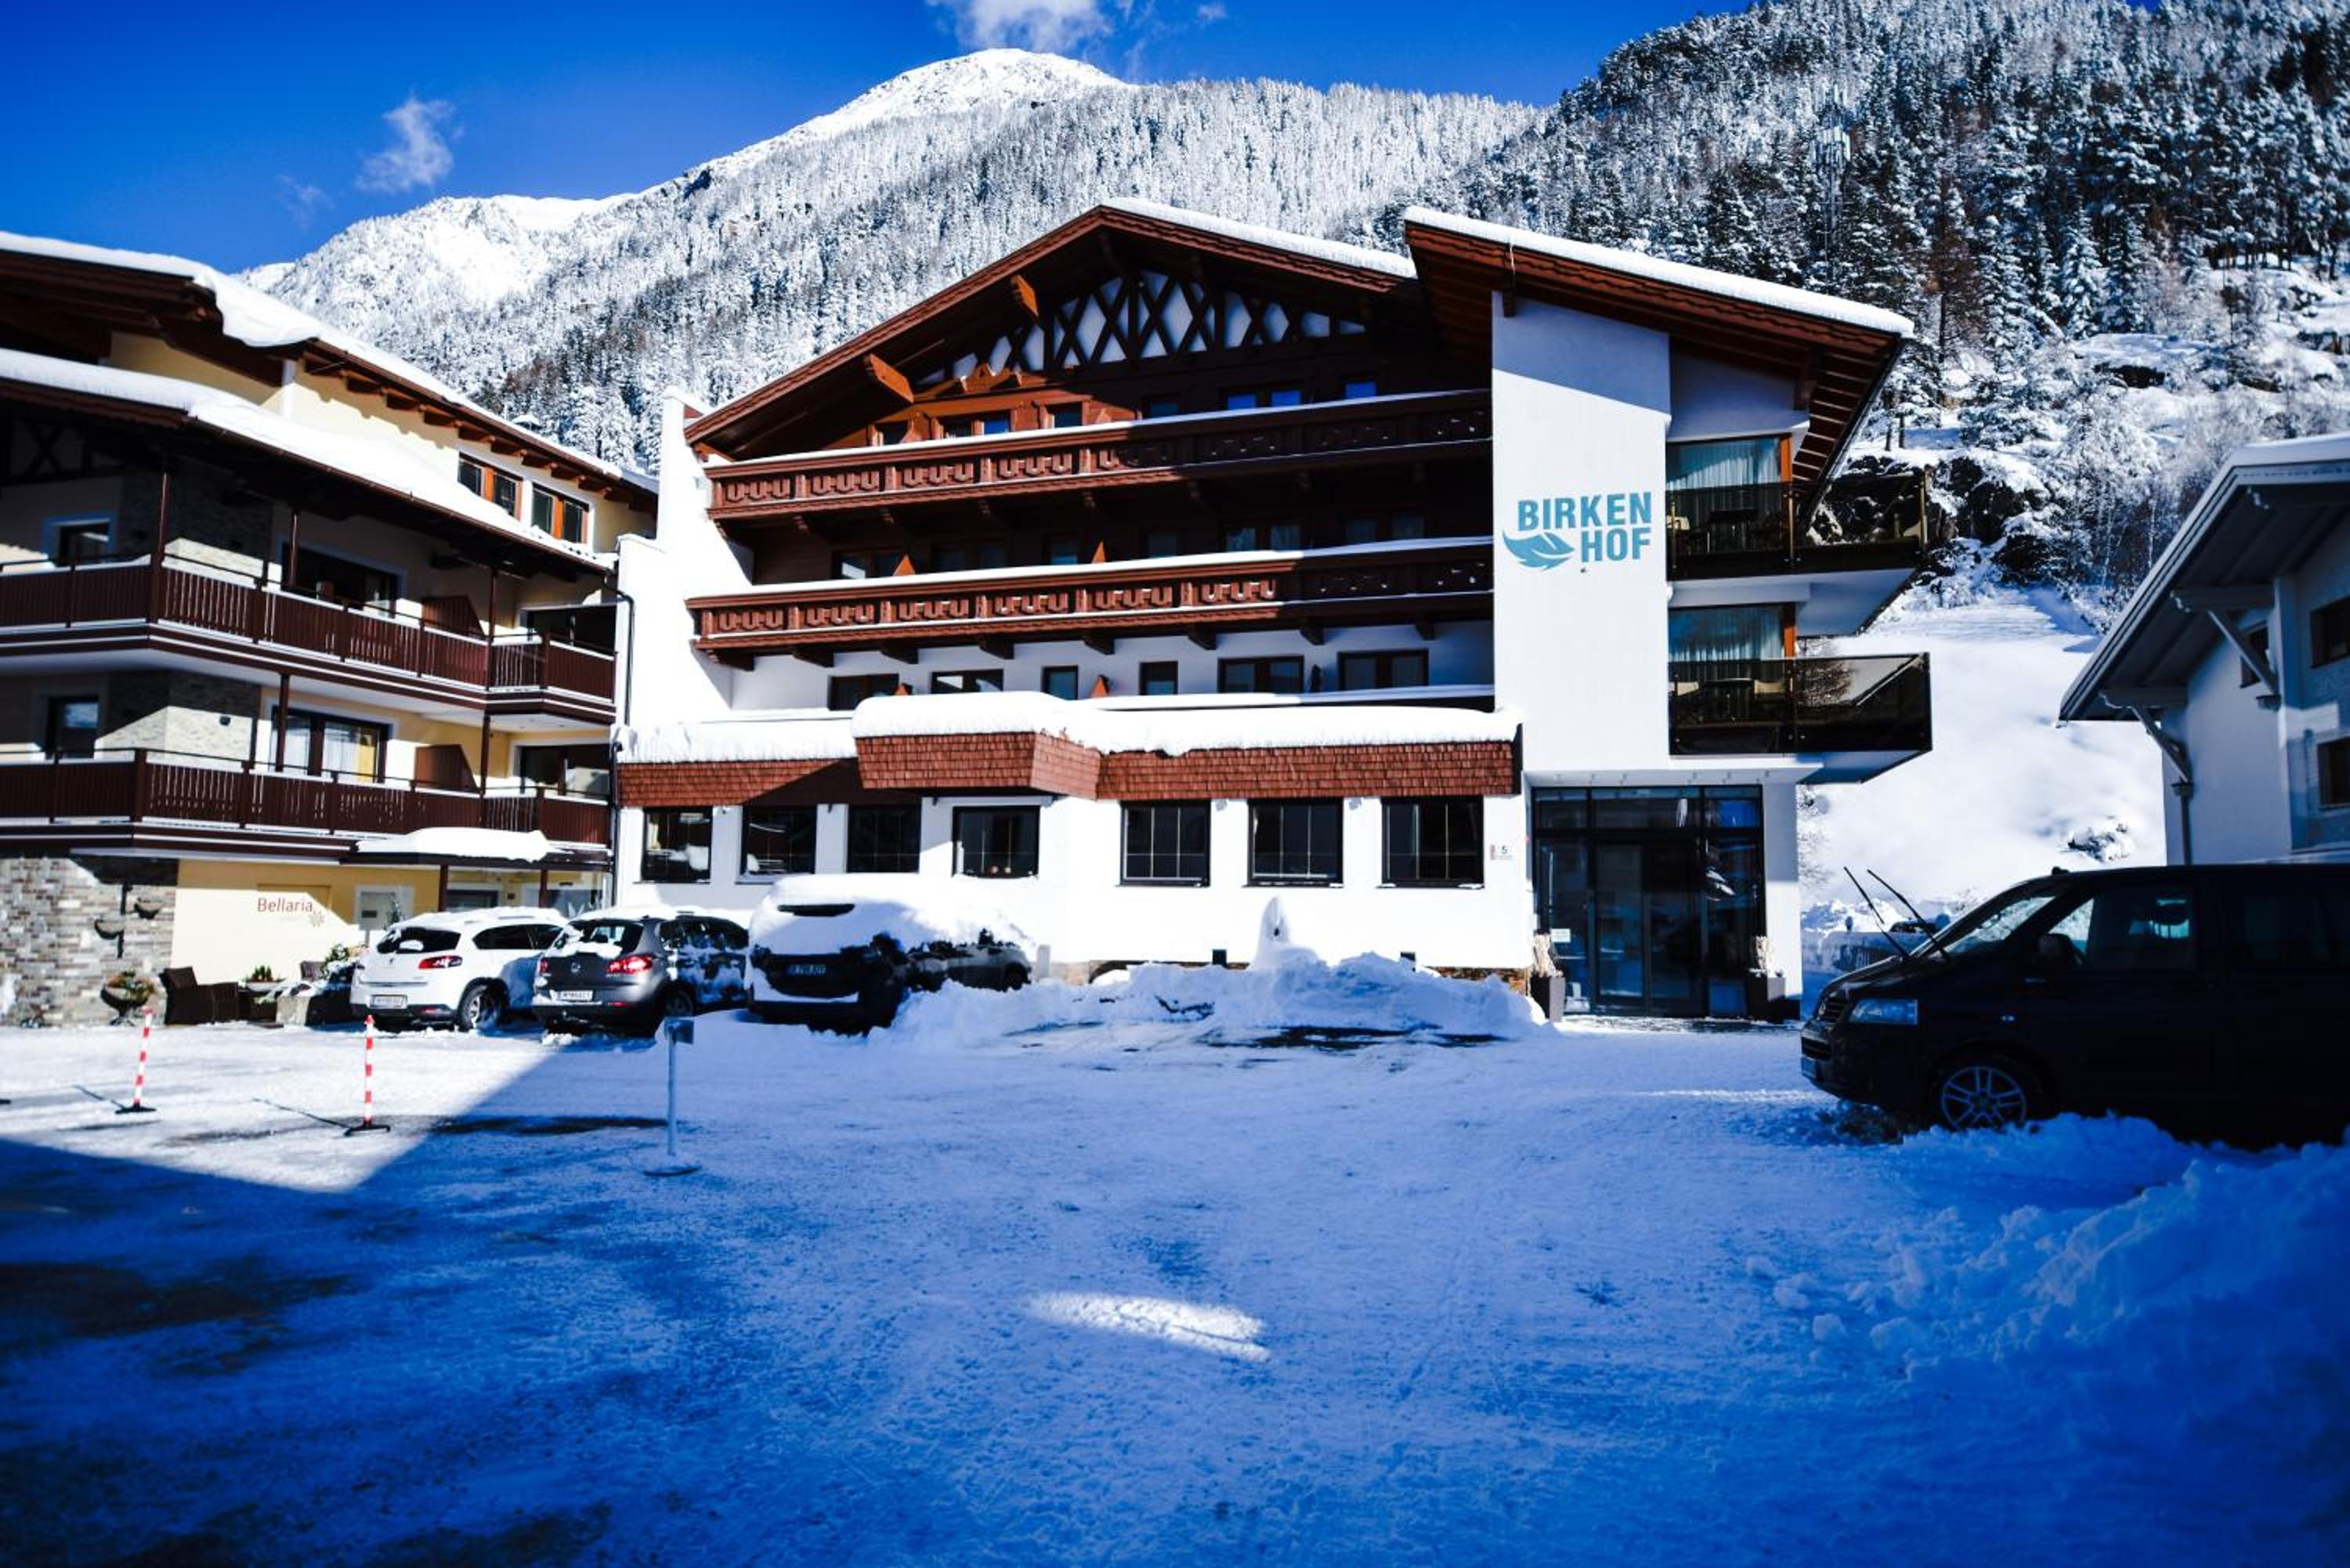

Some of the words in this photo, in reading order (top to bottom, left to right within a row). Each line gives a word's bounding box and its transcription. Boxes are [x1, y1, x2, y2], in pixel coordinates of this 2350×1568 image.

[1517, 492, 1651, 531] BIRKEN
[1582, 527, 1651, 562] HOF
[257, 898, 313, 912] Bellaria
